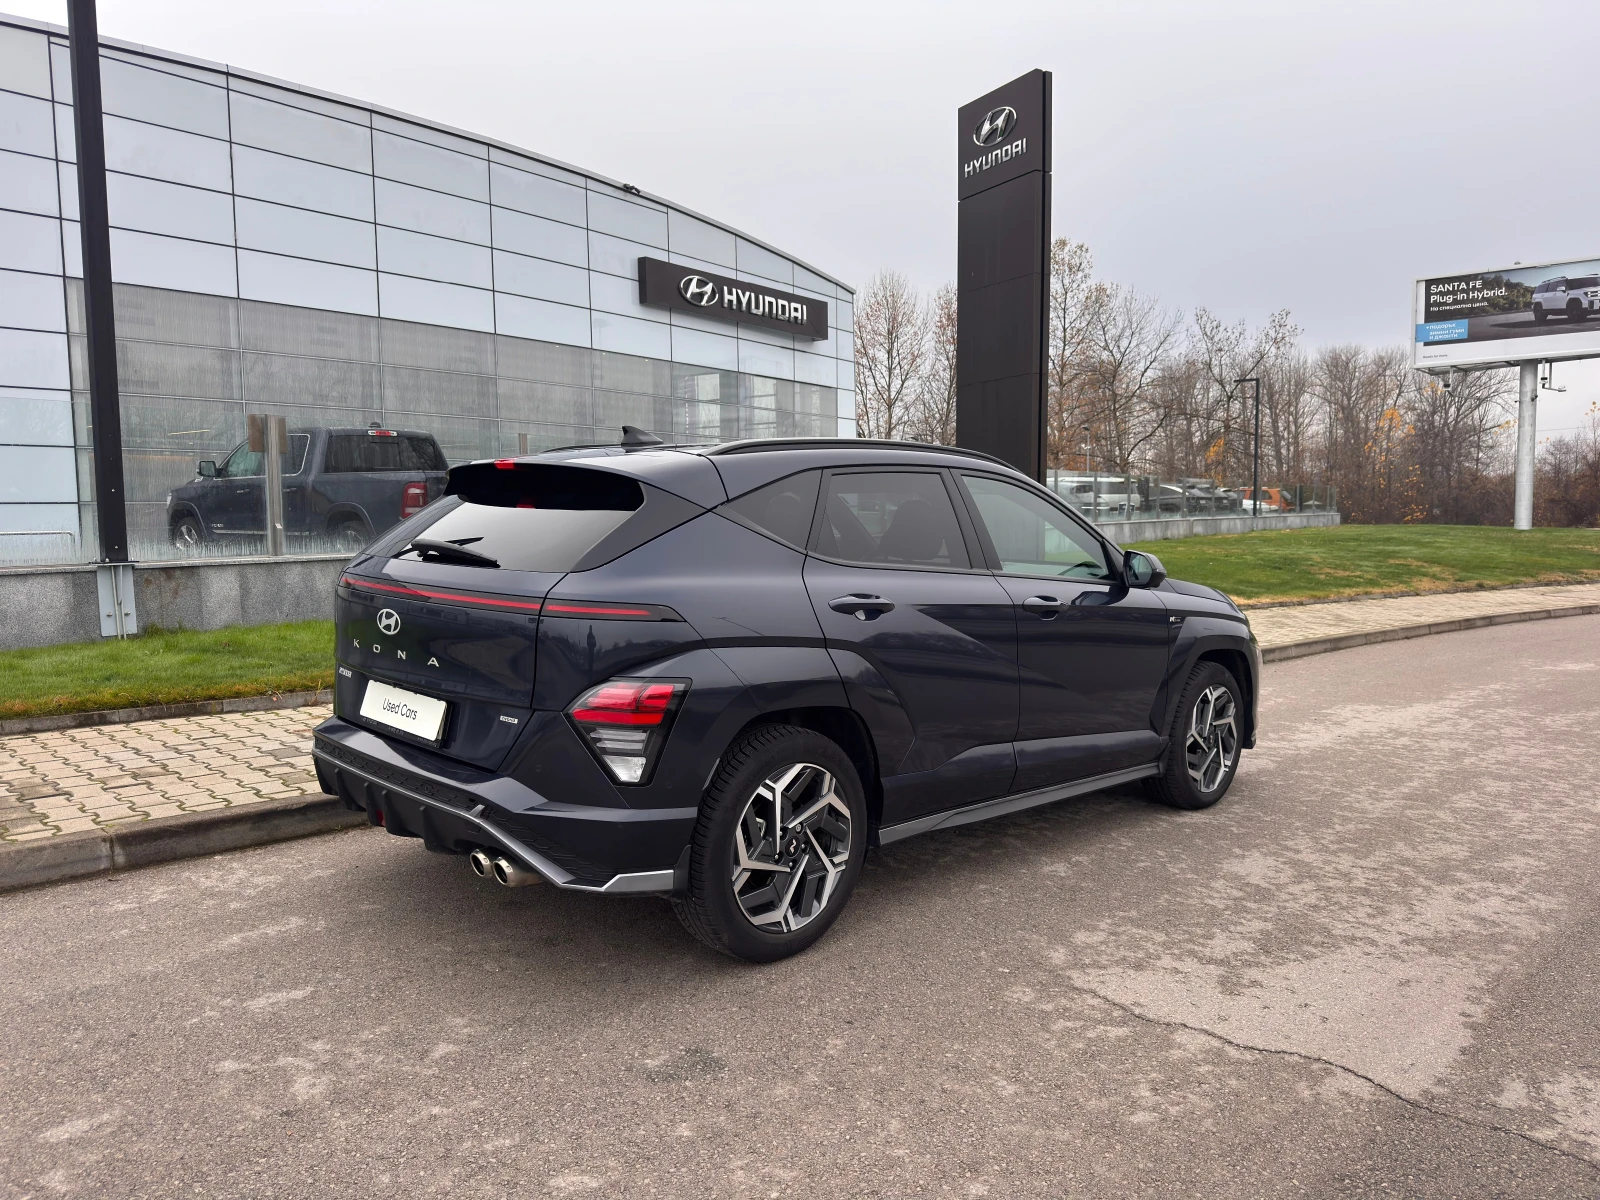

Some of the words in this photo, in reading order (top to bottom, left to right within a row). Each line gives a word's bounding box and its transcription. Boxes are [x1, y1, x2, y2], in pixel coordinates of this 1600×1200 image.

[964, 137, 1027, 178] HYUNDAI
[1430, 282, 1467, 293] SANTA
[1469, 280, 1483, 289] FE
[1430, 292, 1467, 303] Plug-in
[1469, 287, 1508, 300] Hybrid.
[722, 285, 807, 325] HYUNDAI
[353, 638, 440, 667] KONA
[382, 697, 402, 715] Used
[400, 703, 418, 720] Cars
